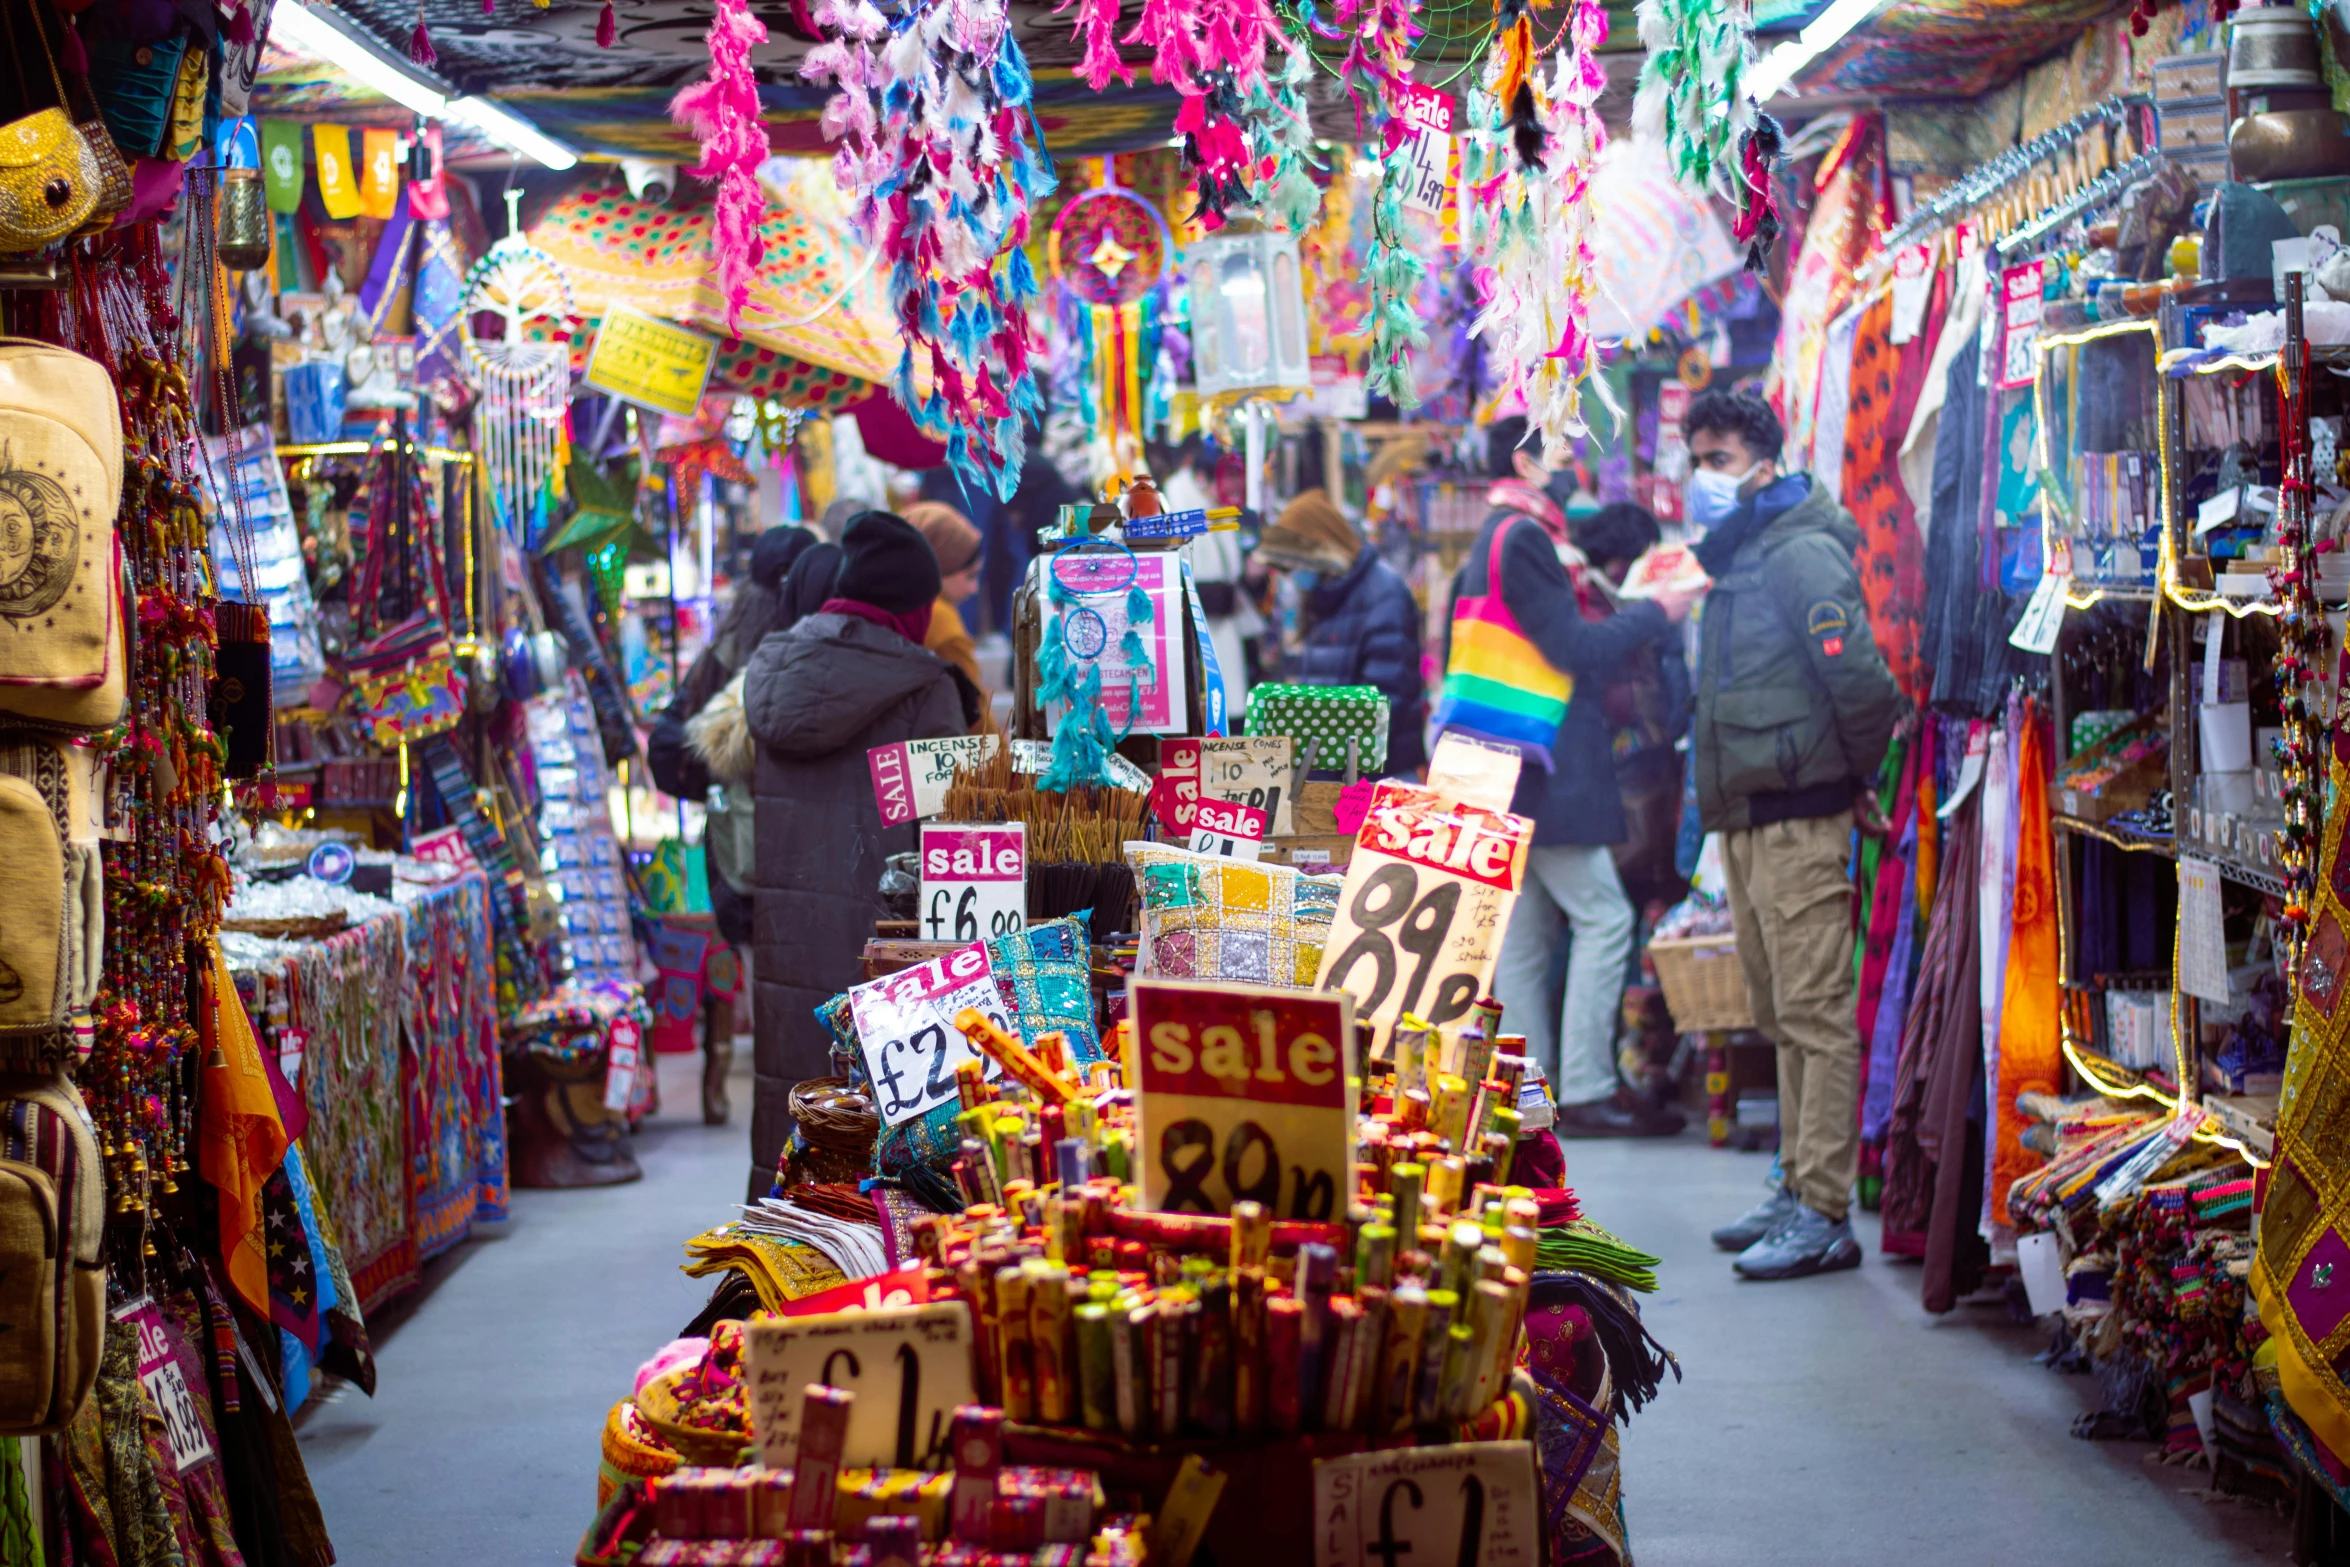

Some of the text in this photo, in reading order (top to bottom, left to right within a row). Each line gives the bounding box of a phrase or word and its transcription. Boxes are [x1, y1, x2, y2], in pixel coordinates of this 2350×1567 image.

[1077, 668, 1148, 680] NASTECAMEN
[1113, 688, 1132, 697] spen
[910, 736, 991, 755] INCENSE
[1200, 739, 1283, 754] INCENSE CONES
[934, 752, 956, 772] 10
[1222, 761, 1243, 781] 10
[876, 749, 909, 821] SALE
[1162, 749, 1199, 825] sale
[1198, 806, 1261, 837] sale
[422, 835, 464, 862] sal
[927, 839, 1021, 875] sale
[1376, 808, 1510, 878] sale
[1150, 1009, 1337, 1087] sale
[138, 1317, 169, 1367] ale
[1327, 1473, 1353, 1567] SAL
